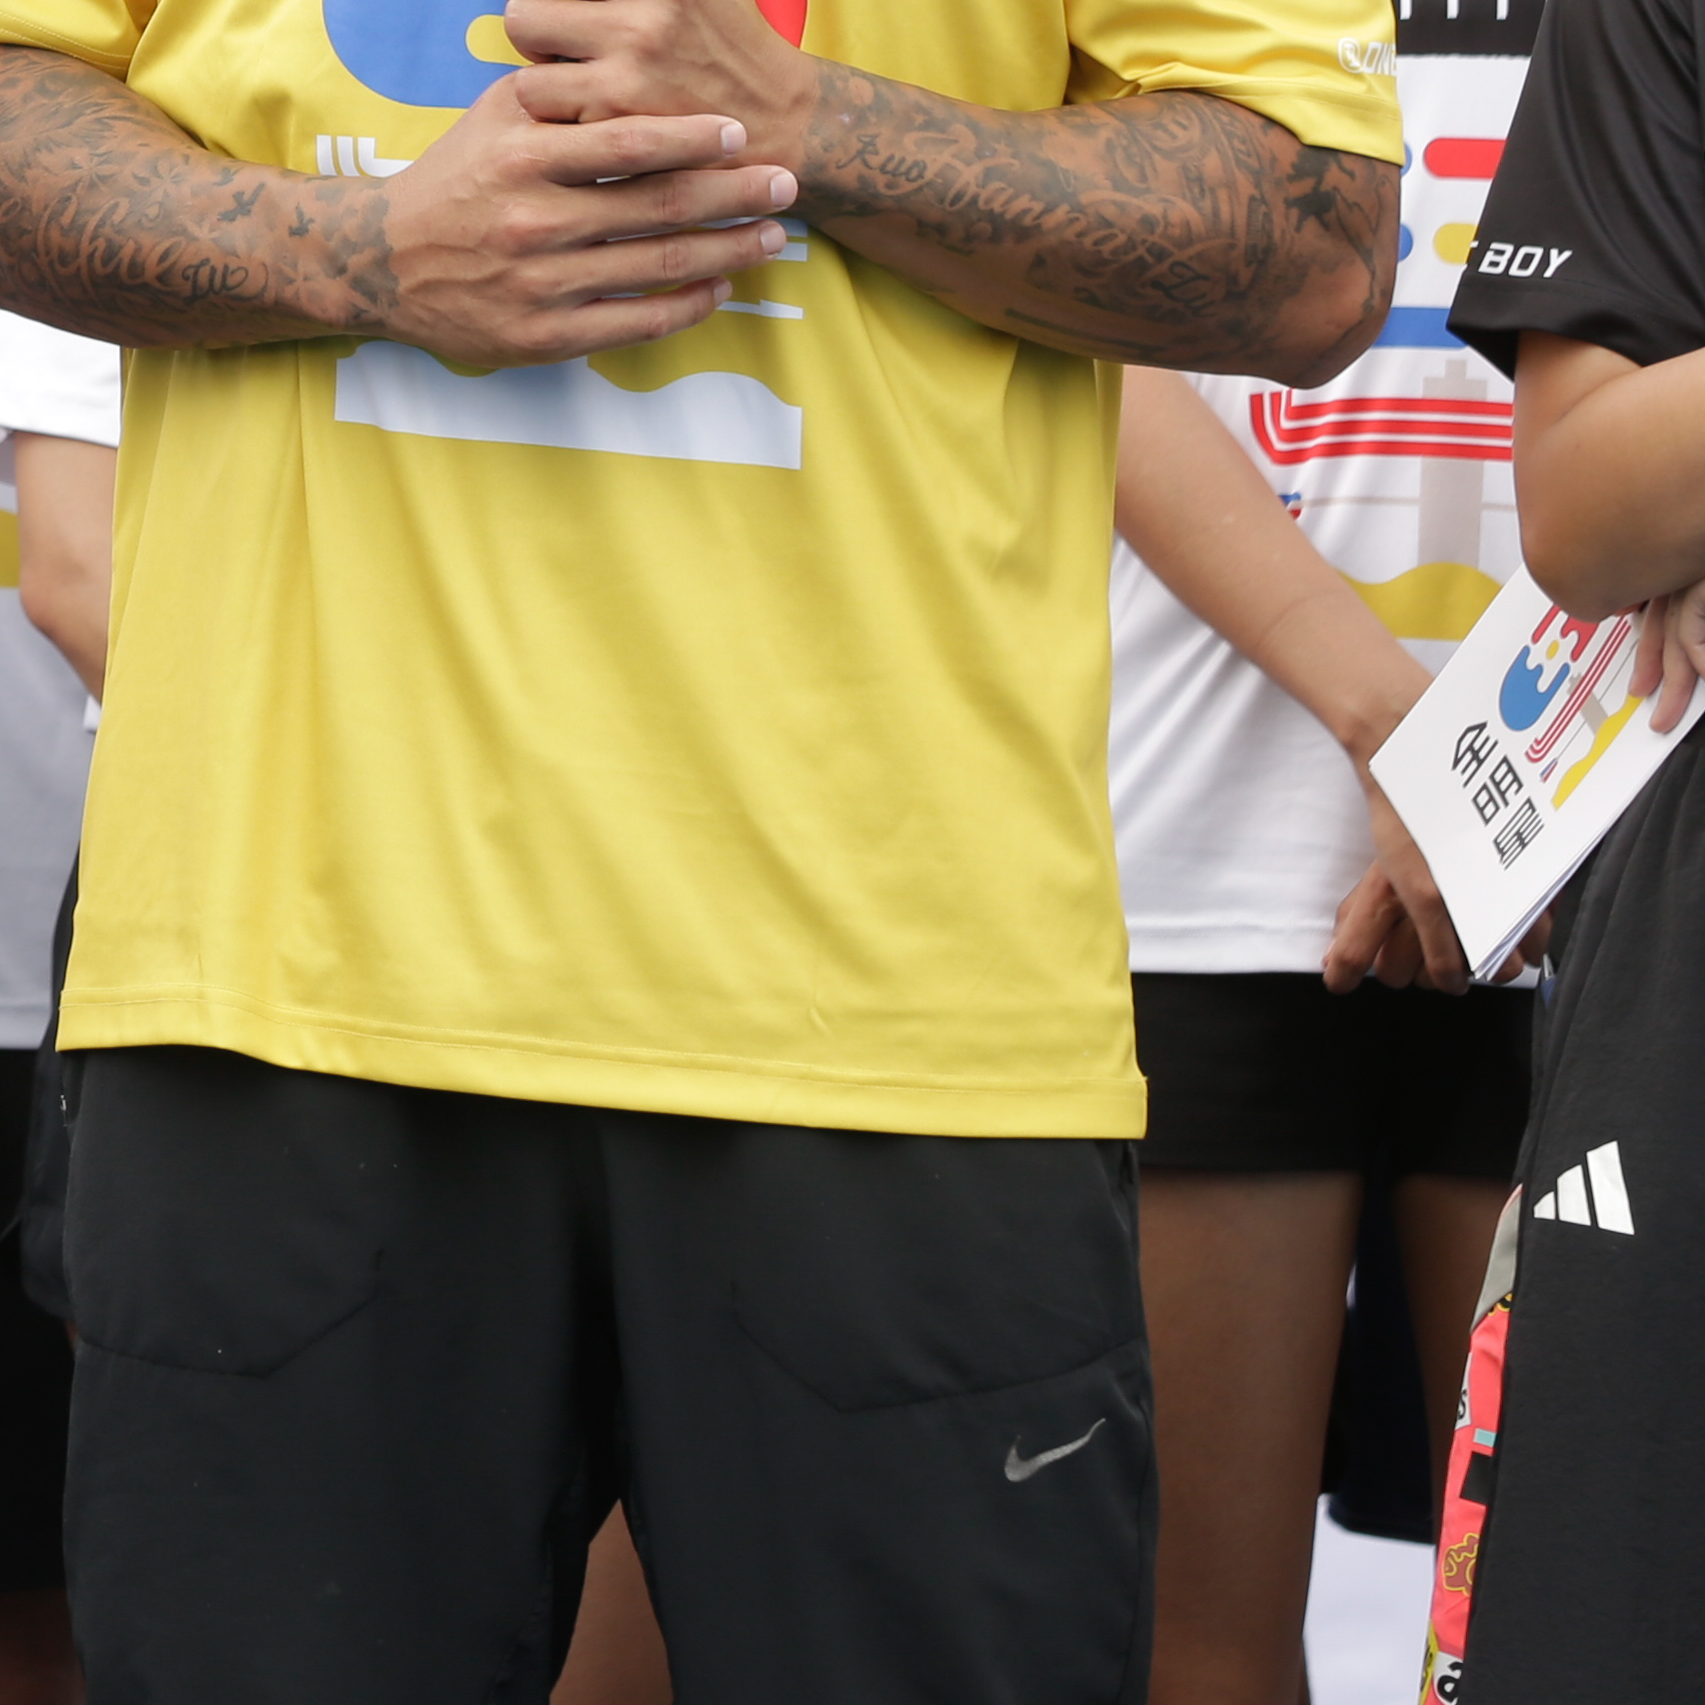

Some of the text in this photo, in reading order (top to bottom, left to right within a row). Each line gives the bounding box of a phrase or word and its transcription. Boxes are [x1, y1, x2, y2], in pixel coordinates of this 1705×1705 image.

[1478, 242, 1573, 278] BOY
[1450, 721, 1545, 871] 全明星
